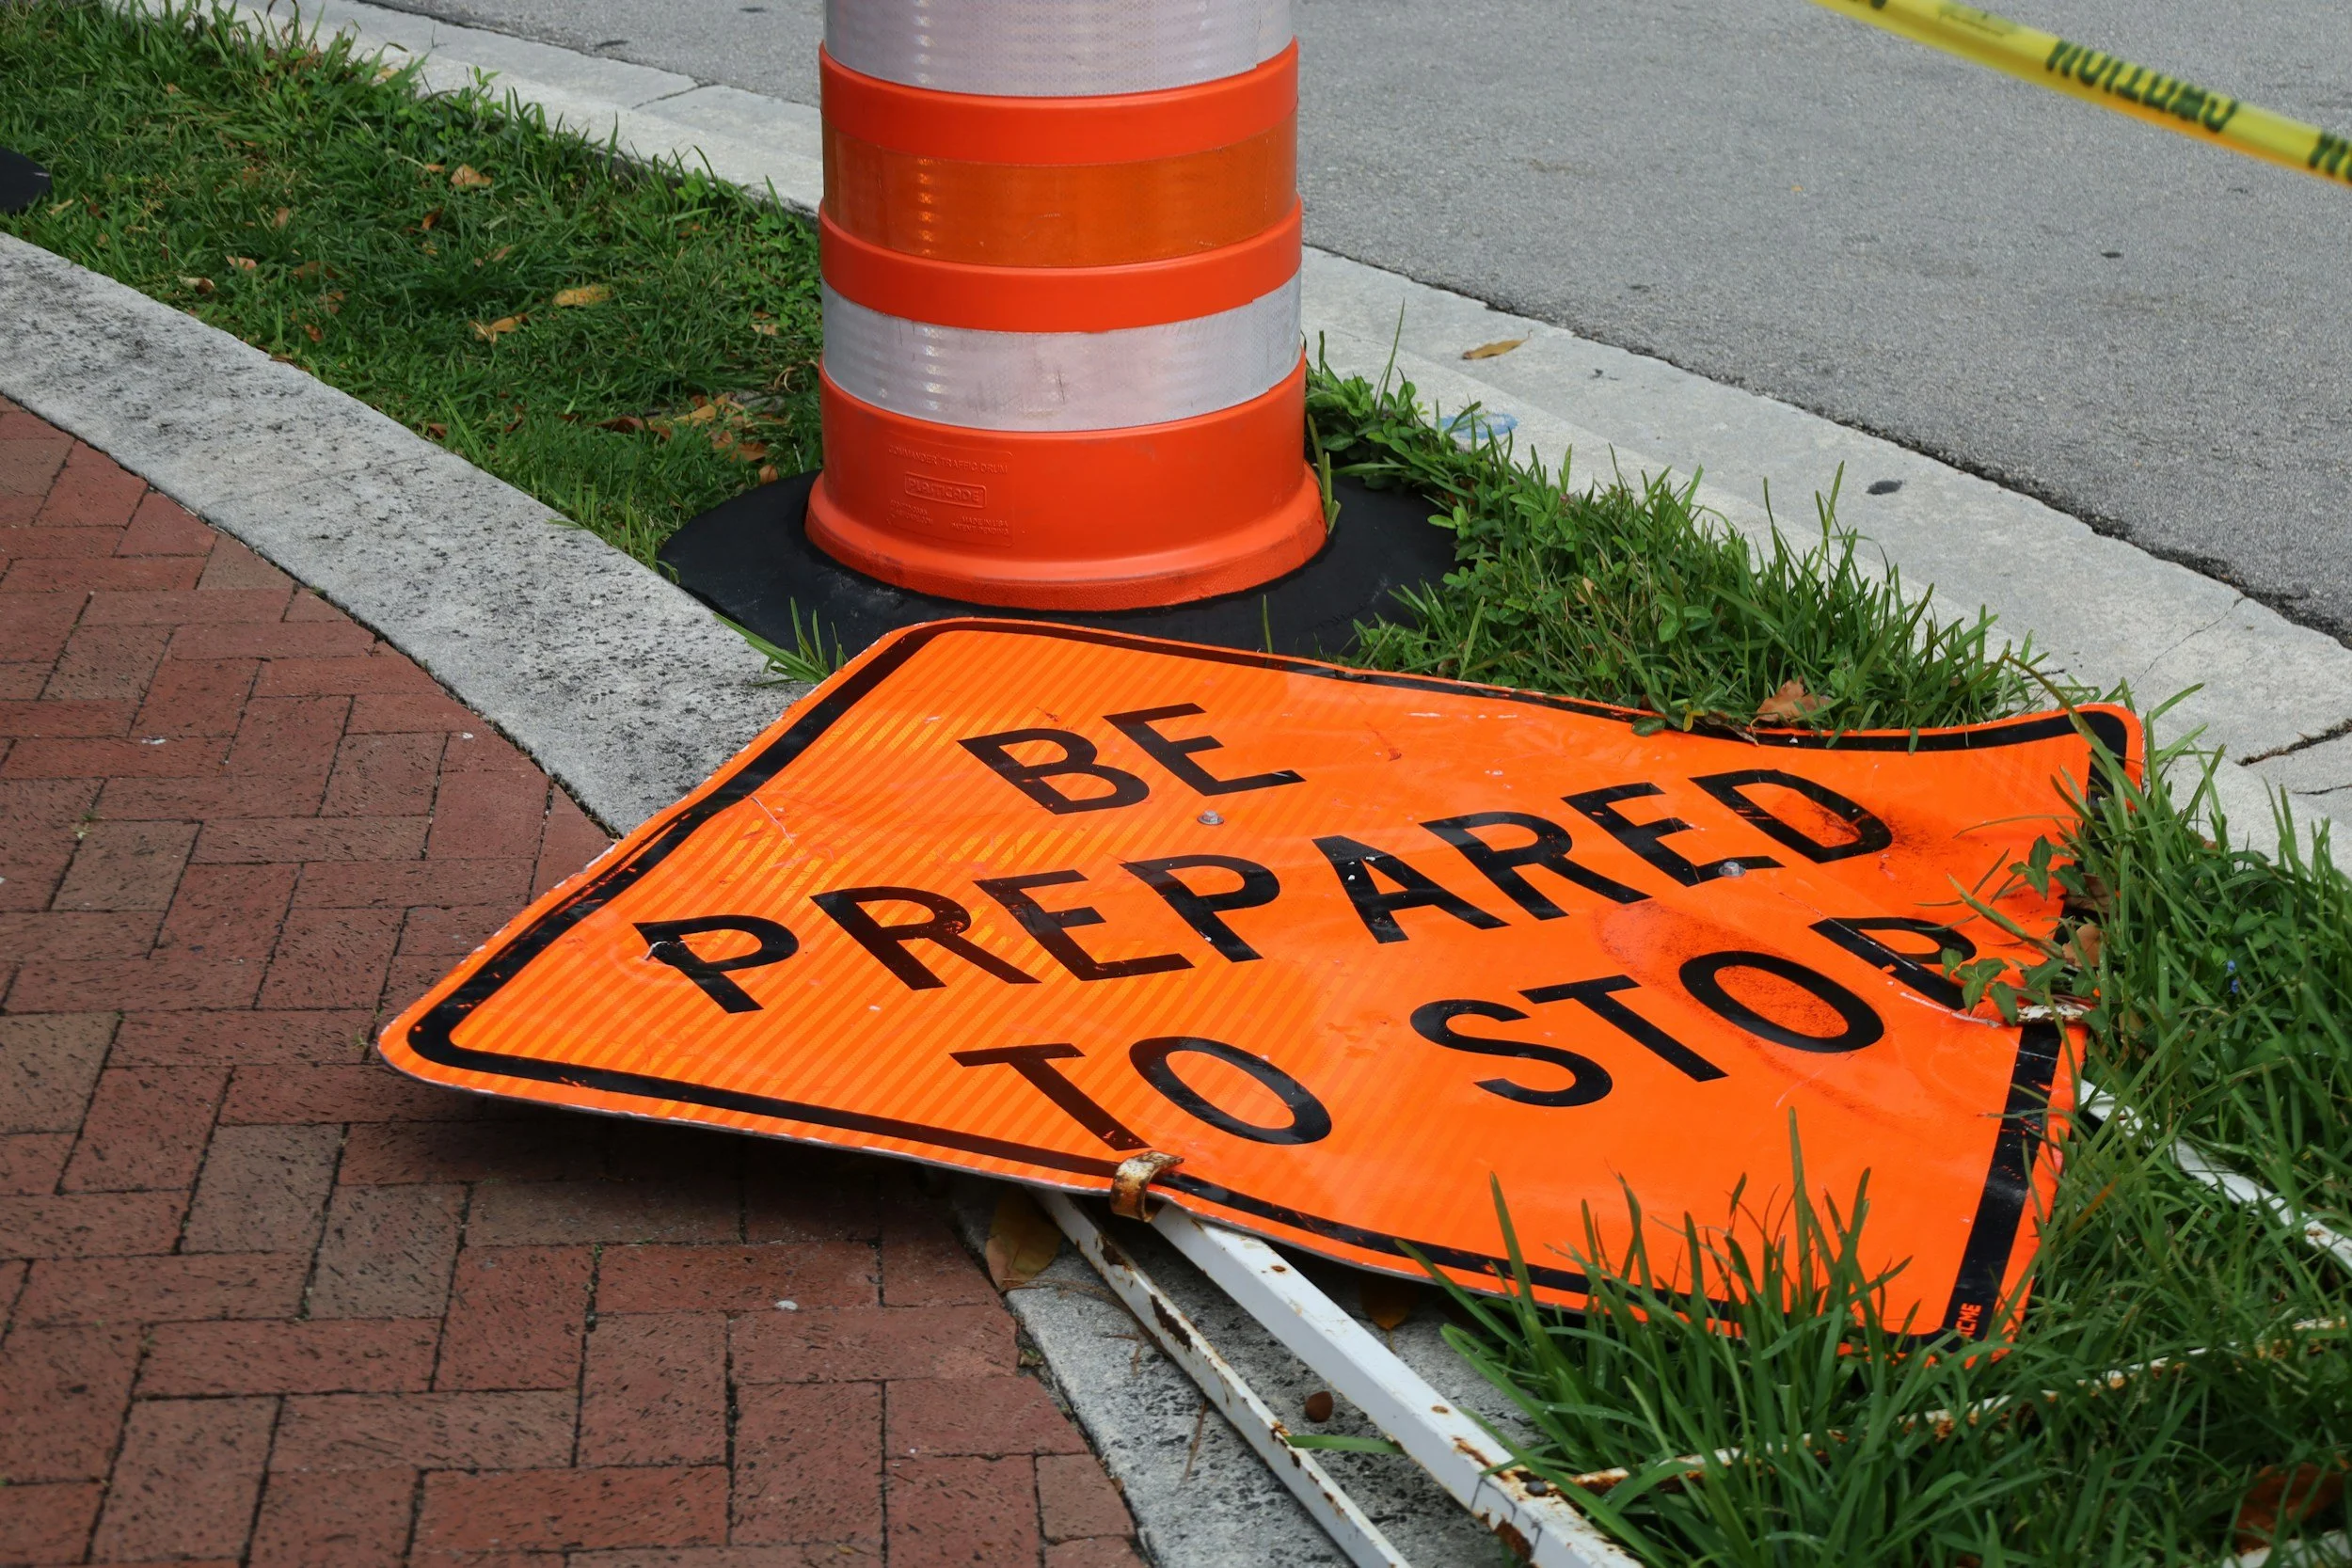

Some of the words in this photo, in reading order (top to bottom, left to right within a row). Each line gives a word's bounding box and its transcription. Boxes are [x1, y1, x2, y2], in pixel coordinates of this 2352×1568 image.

[980, 463, 1009, 475] DRUM
[957, 703, 1307, 816] BE
[632, 768, 1894, 1014] PREPARED
[949, 1036, 1332, 1151] TO
[1409, 916, 1979, 1107] STOP
